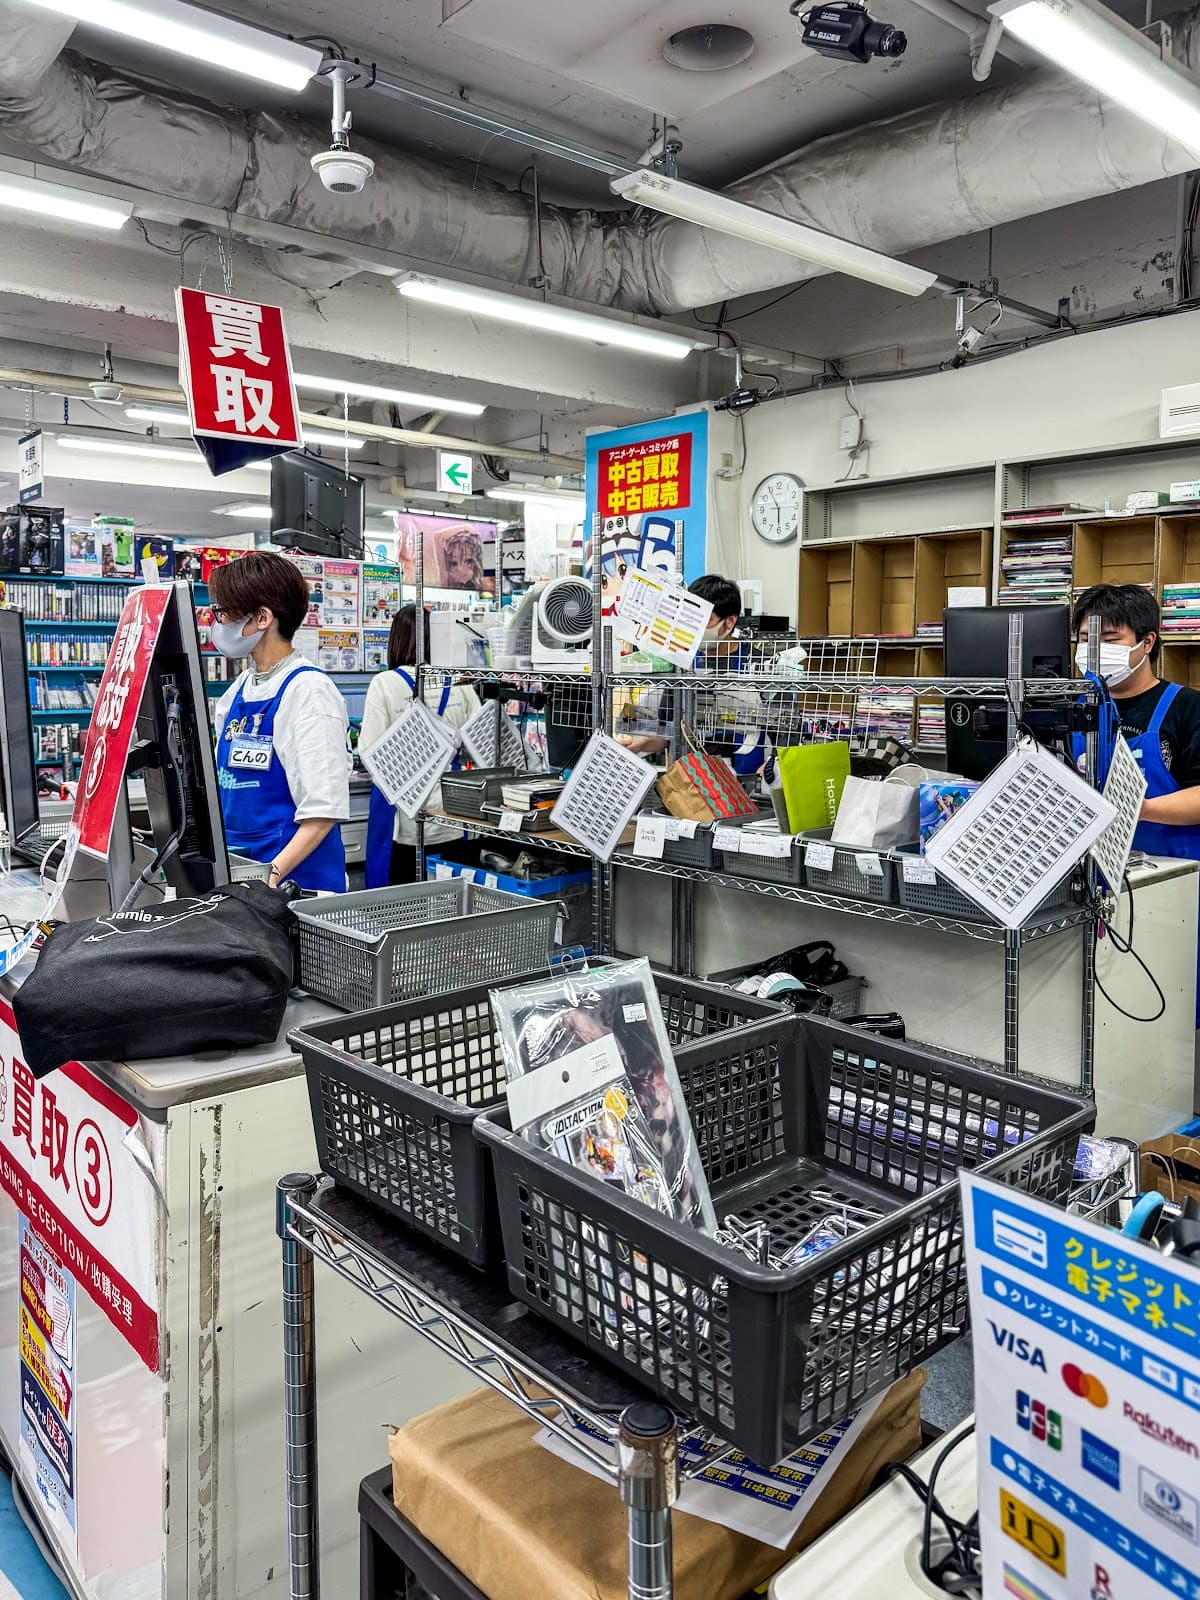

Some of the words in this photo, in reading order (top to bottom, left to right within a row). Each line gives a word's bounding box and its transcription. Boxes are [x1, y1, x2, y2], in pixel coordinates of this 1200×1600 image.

[205, 295, 281, 436] 買取
[607, 480, 679, 514] 中古販売
[608, 452, 680, 487] 中古買取
[503, 550, 525, 560] ベス
[1064, 1237, 1192, 1310] クレジット
[985, 1318, 1048, 1374] VISA
[1016, 1389, 1062, 1452] JCB
[1123, 1400, 1199, 1459] Rakuten
[1008, 1501, 1060, 1560] iD
